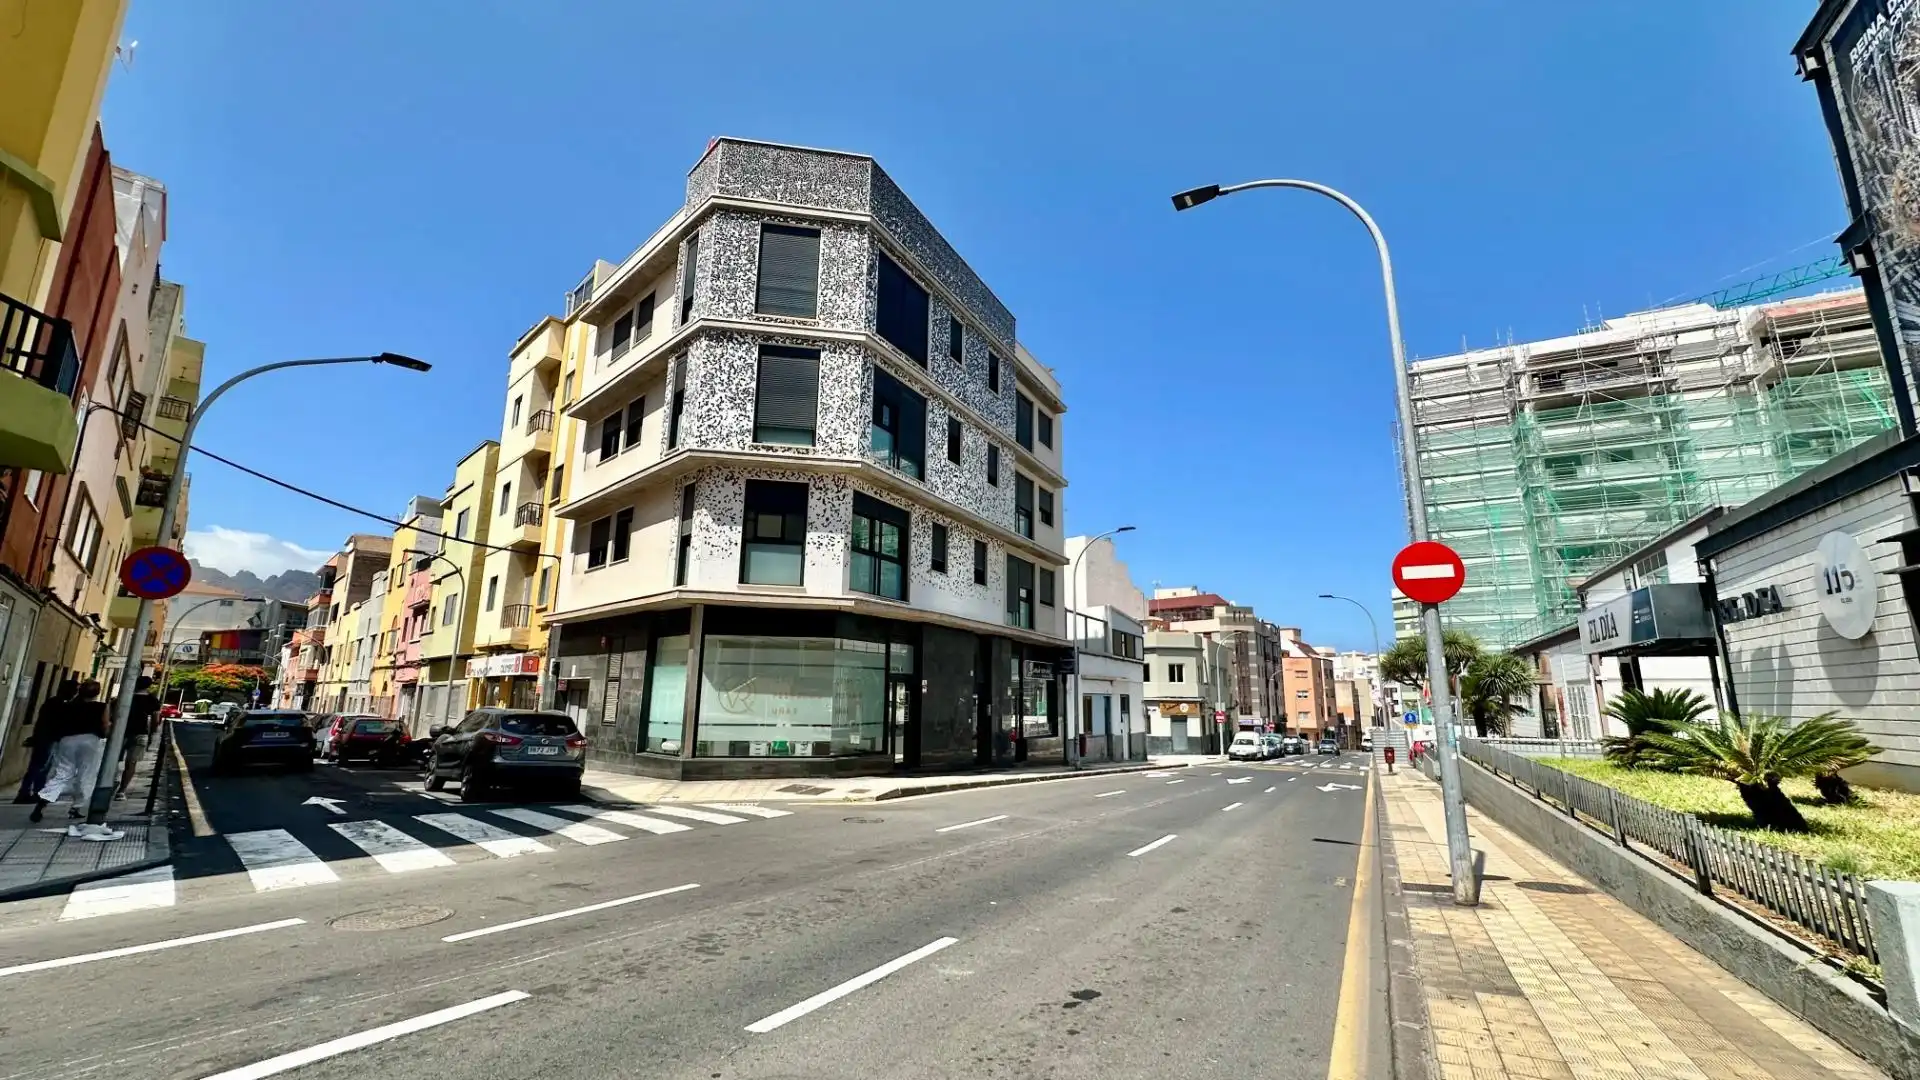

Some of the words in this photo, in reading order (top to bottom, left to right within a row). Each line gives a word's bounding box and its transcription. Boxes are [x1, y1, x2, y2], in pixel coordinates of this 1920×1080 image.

[1850, 12, 1887, 65] REINA
[1863, 25, 1890, 61] SANTA
[1823, 563, 1855, 595] 115
[1587, 618, 1601, 644] EL
[1598, 607, 1619, 641] DÍA
